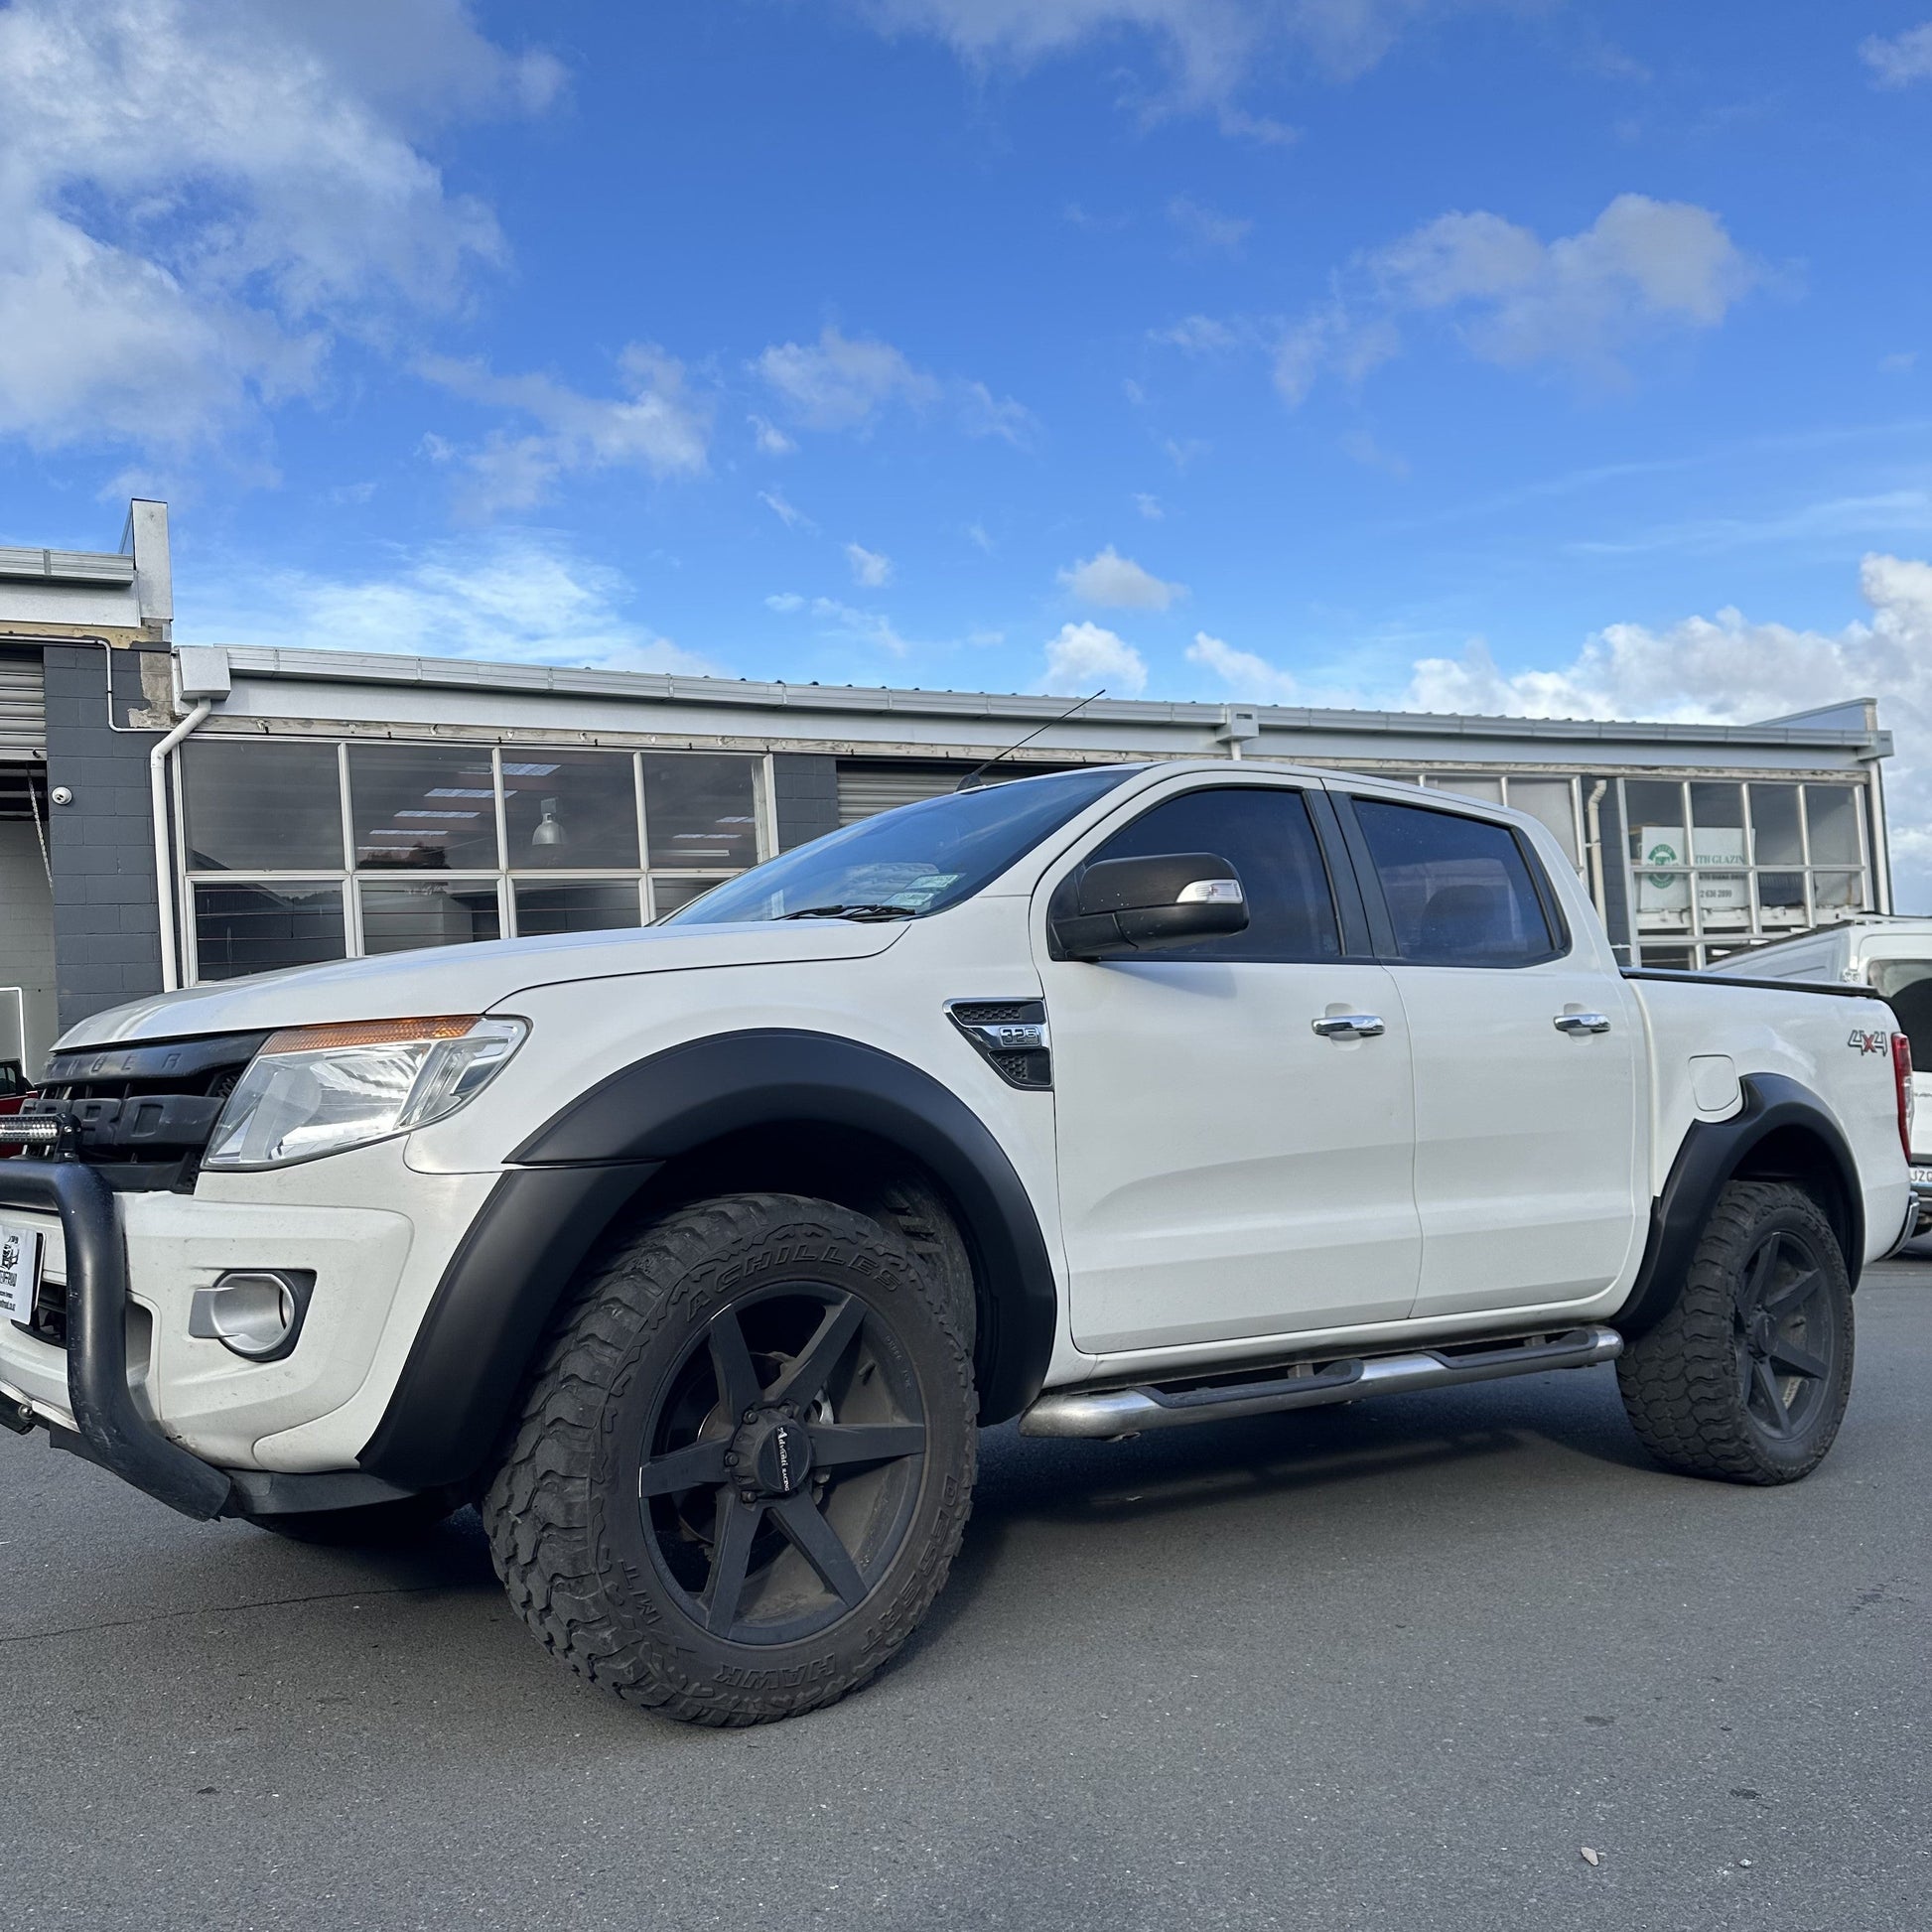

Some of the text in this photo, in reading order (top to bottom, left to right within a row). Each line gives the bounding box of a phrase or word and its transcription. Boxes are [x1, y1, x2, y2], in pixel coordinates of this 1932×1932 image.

[1711, 854, 1747, 865] GLAZIN
[687, 1244, 902, 1322] ACHILLES
[713, 1652, 836, 1690] HAWK
